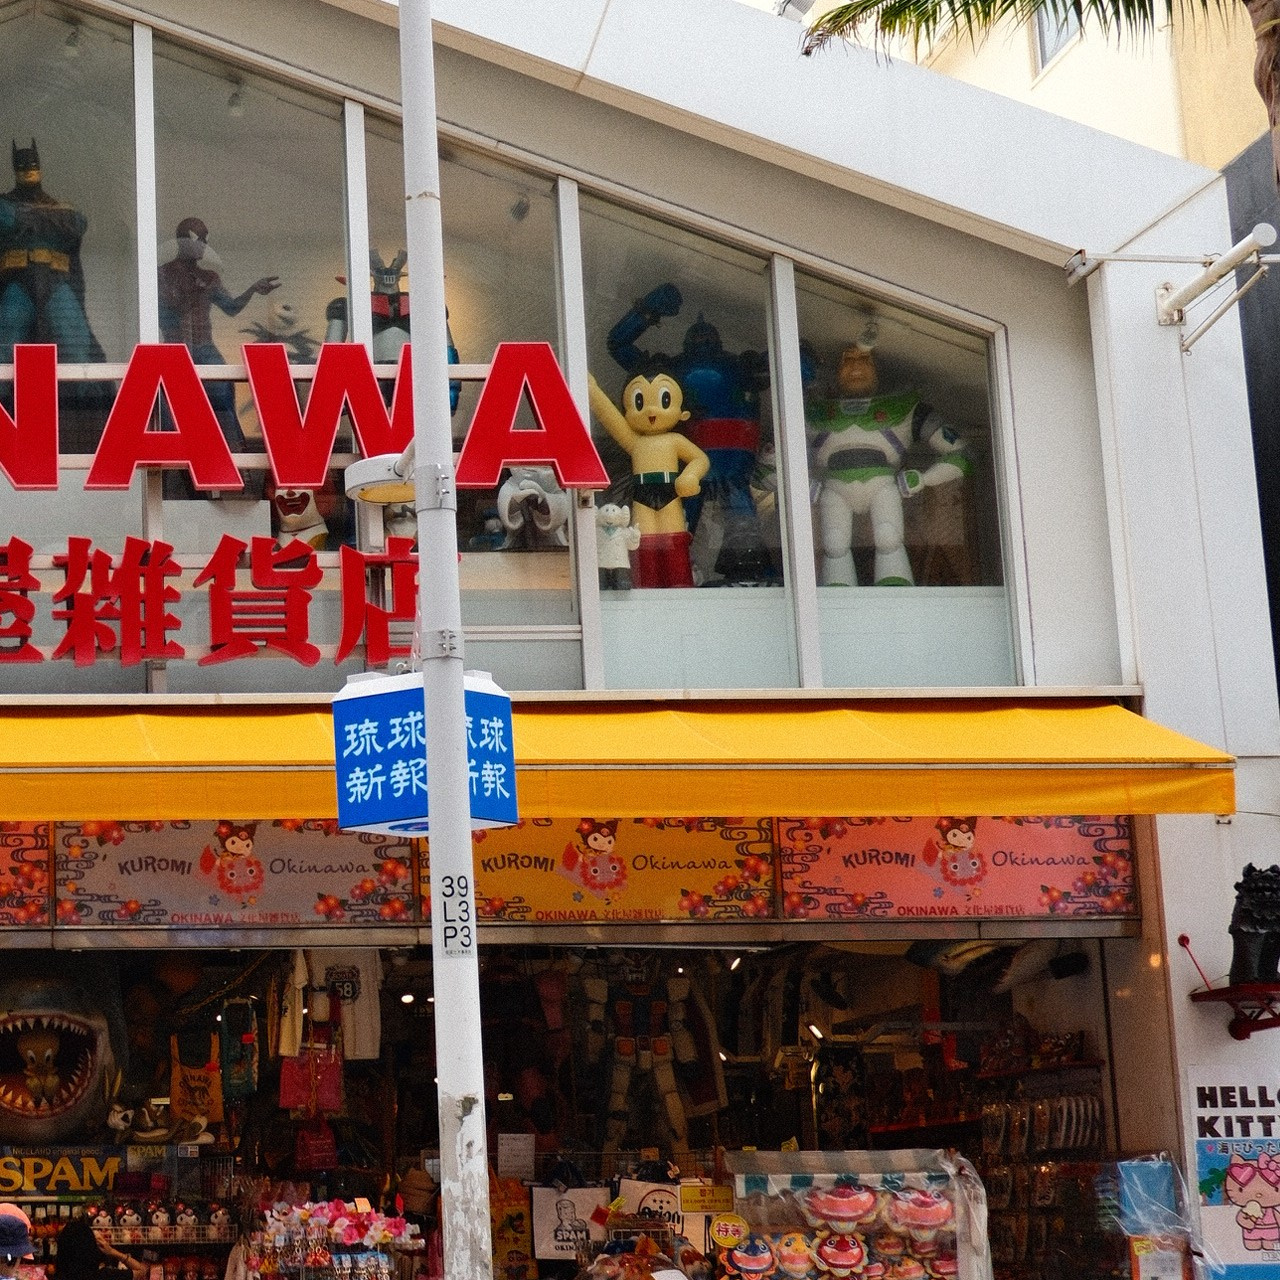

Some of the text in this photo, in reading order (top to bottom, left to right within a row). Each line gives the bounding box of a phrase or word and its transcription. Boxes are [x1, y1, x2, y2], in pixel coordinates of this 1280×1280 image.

[343, 710, 426, 759] 琉球
[346, 758, 428, 804] 新報
[118, 856, 370, 876] KUROMI Okinawa
[481, 853, 732, 873] KUROMI Okinawa
[842, 849, 1091, 868] KUROMI Okinawa
[442, 875, 468, 898] 39
[171, 913, 233, 924] OKINAWA
[443, 900, 470, 922] L3
[535, 910, 597, 920] OKINAWA
[897, 906, 958, 916] OKINAWA
[444, 925, 472, 948] P3
[335, 982, 353, 998] 58
[1197, 1086, 1280, 1109] HELL
[1197, 1115, 1280, 1138] KITT
[1219, 1142, 1280, 1155] 海にぴった
[557, 1230, 587, 1241] SPAM
